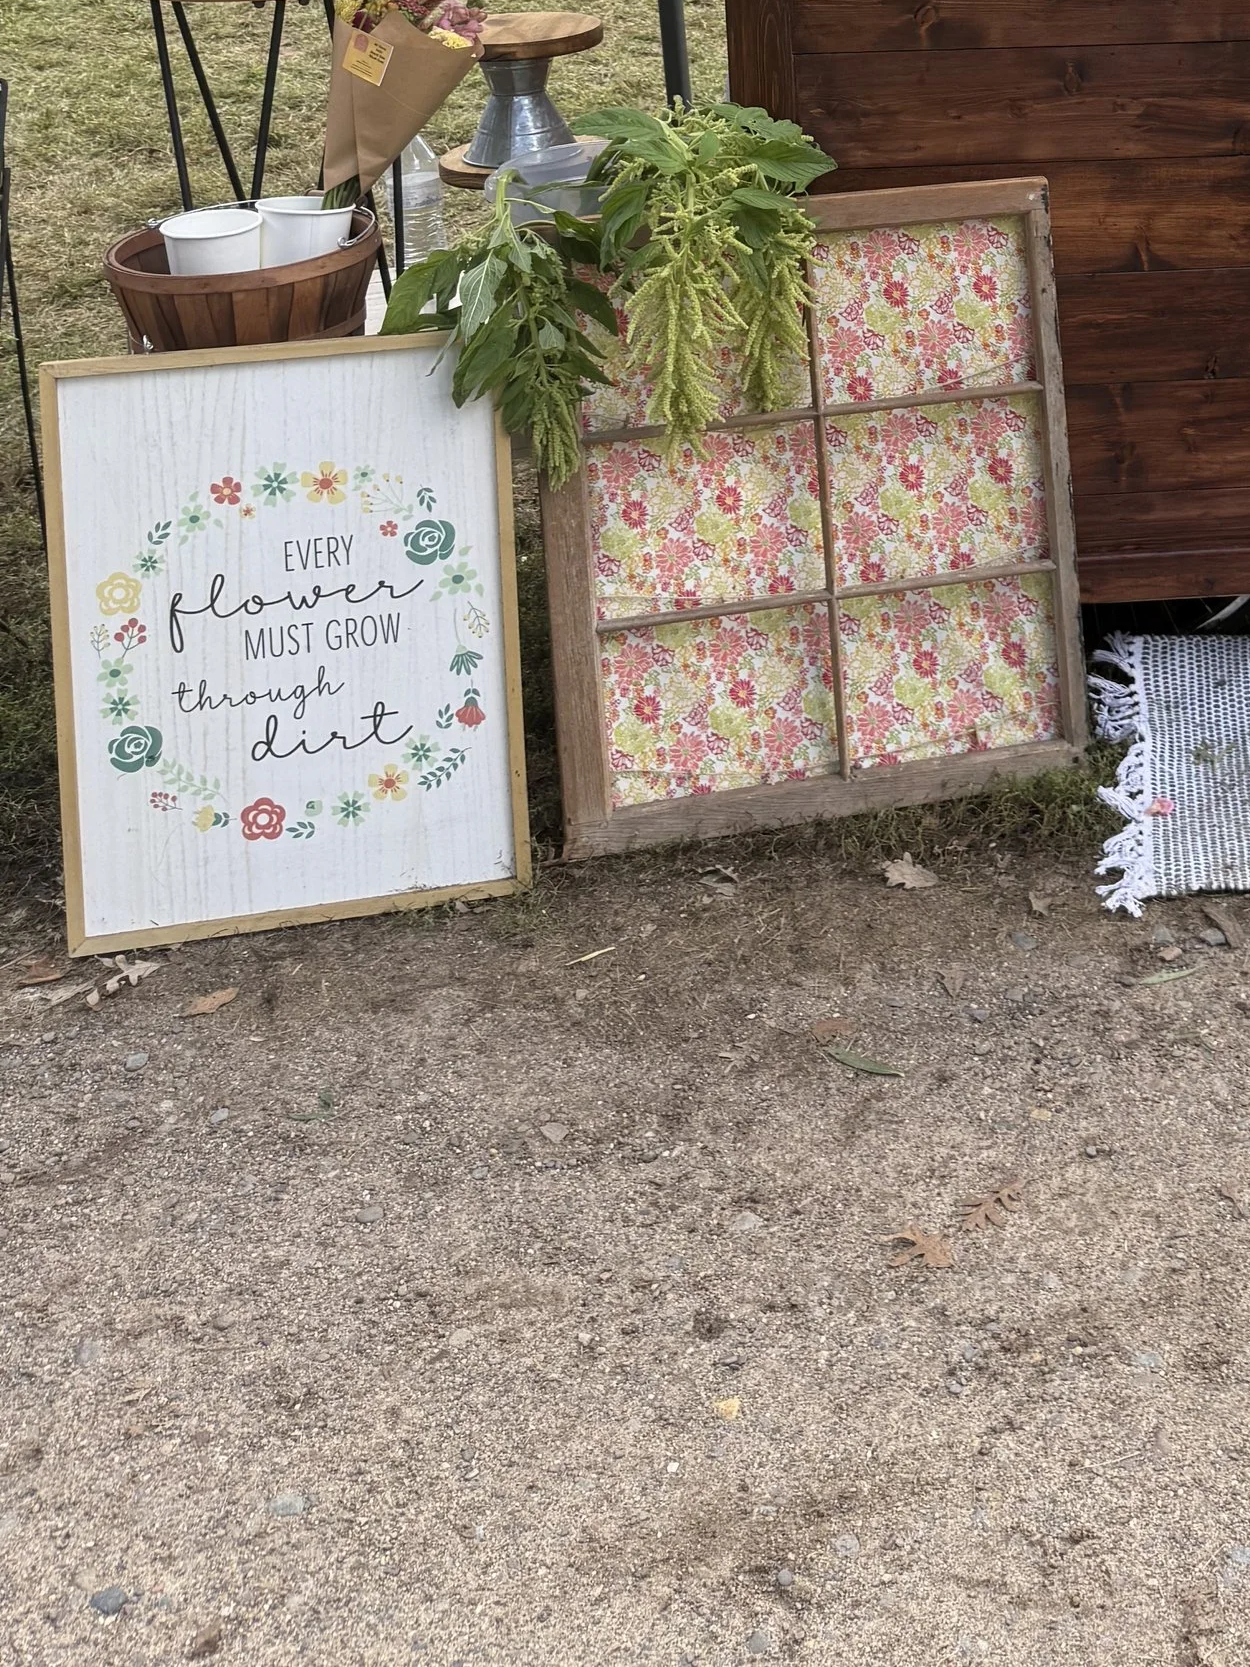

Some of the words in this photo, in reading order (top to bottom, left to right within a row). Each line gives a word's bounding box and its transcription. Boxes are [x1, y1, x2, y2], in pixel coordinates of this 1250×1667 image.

[283, 534, 354, 573] EVERY
[168, 573, 425, 654] flower
[243, 623, 312, 661] MUST
[325, 612, 401, 651] GROW
[171, 665, 345, 720] through
[250, 700, 414, 762] dirt
